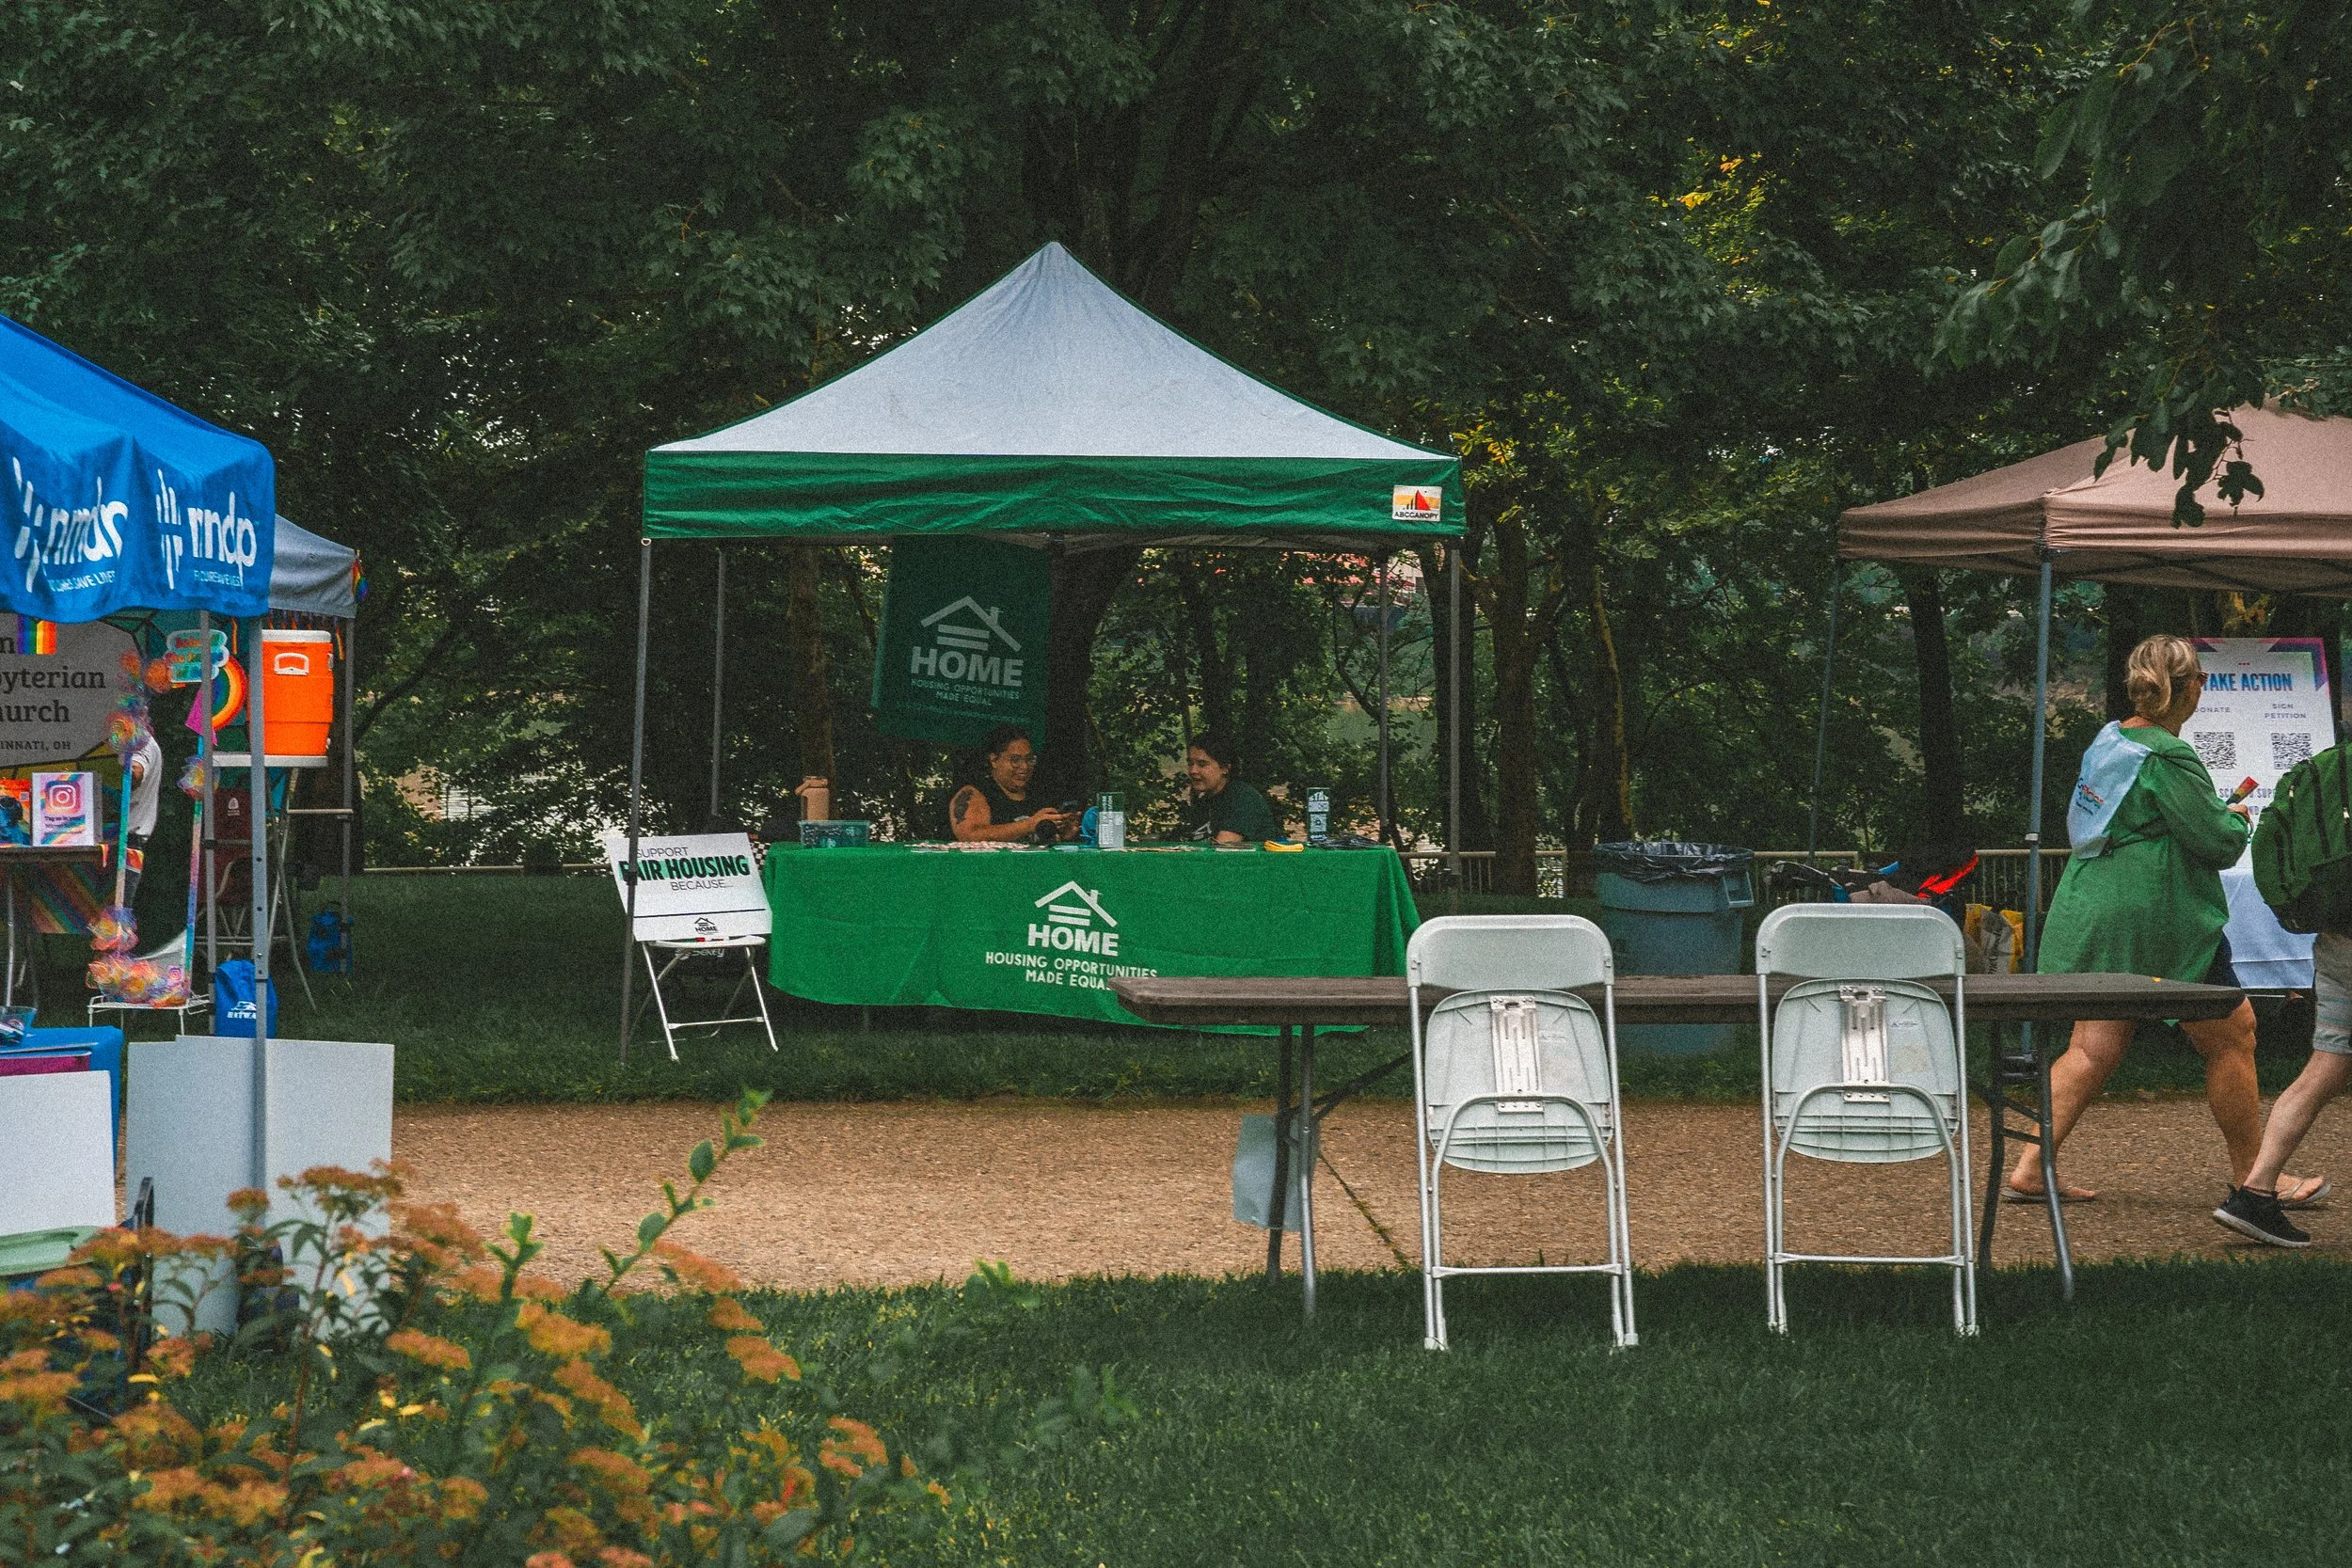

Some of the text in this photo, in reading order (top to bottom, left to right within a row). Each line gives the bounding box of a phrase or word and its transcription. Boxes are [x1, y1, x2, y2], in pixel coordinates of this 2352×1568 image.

[911, 646, 1025, 688] HOME
[0, 666, 106, 694] yterian
[911, 678, 1020, 700] HOUSING OPPORTUNITIES
[2241, 673, 2293, 691] ACTION
[936, 690, 992, 705] MADE EQUAL
[0, 699, 71, 722] urch
[53, 740, 71, 750] OH
[637, 847, 689, 858] SUPPORT
[664, 854, 750, 879] HOUSING
[1027, 923, 1120, 957] HOME
[985, 951, 1157, 977] HOUSING OPPORTUNITIES
[1025, 969, 1063, 985] MADE
